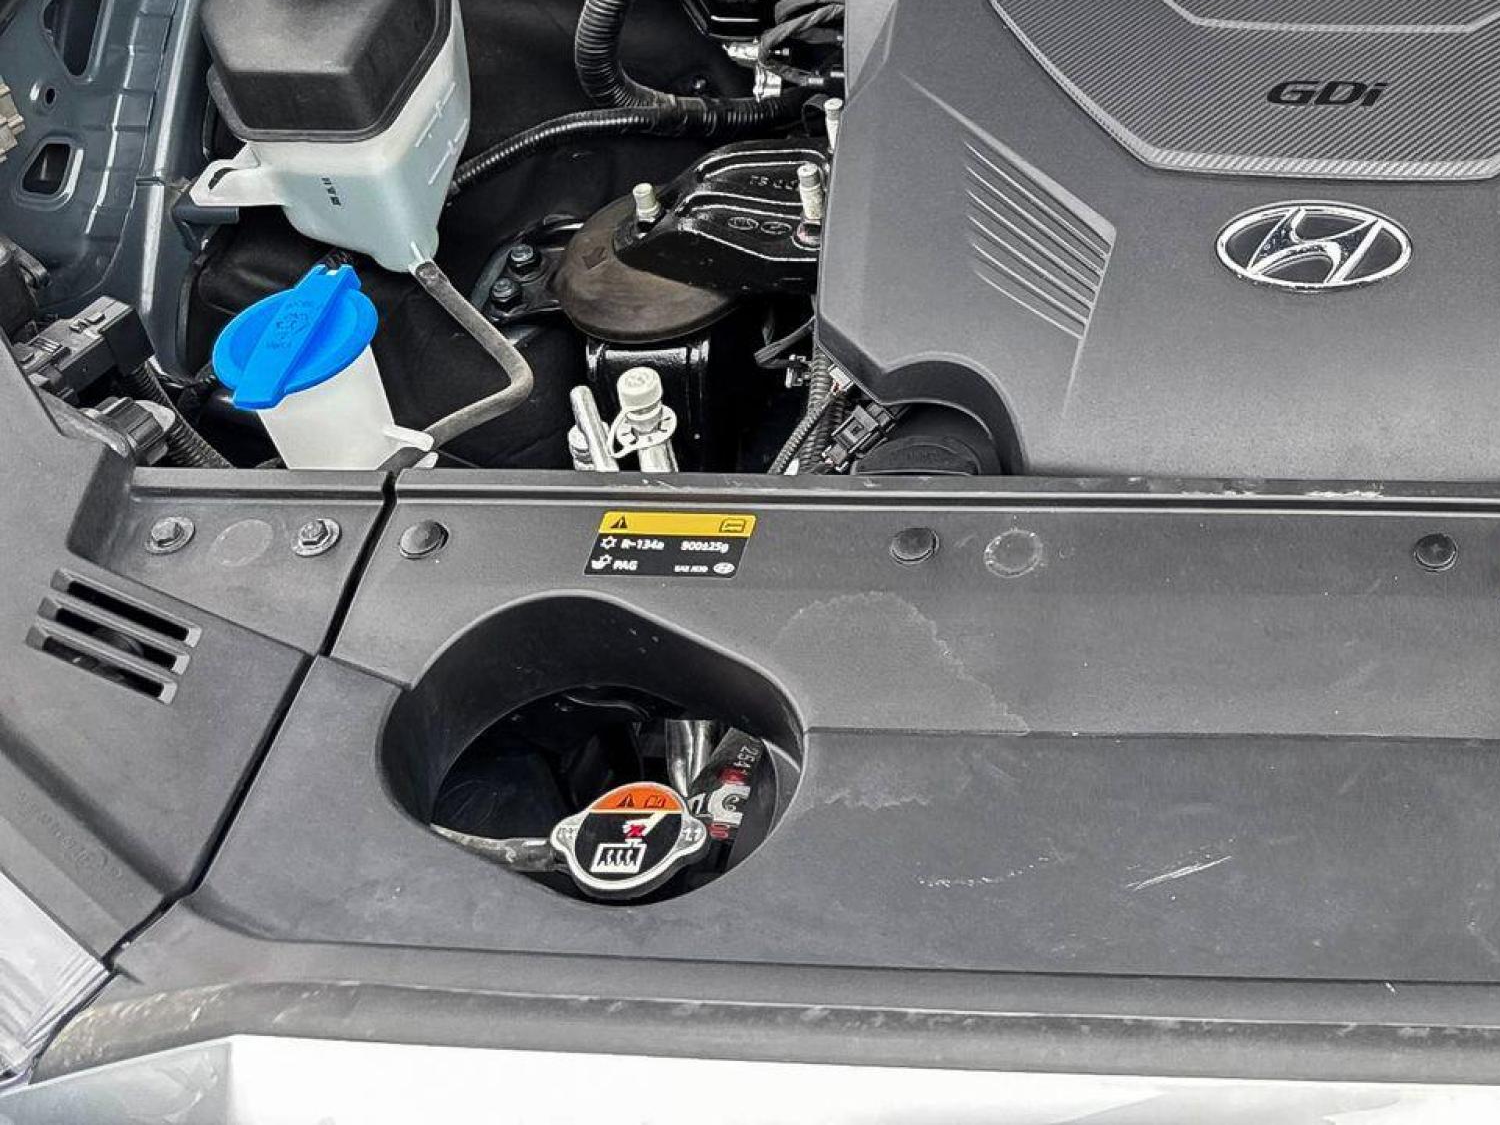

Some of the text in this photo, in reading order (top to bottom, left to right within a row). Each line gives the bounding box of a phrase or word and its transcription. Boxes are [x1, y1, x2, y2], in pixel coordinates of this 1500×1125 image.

[1266, 80, 1389, 107] GDi
[620, 538, 665, 551] R-134a
[612, 560, 639, 571] PAG
